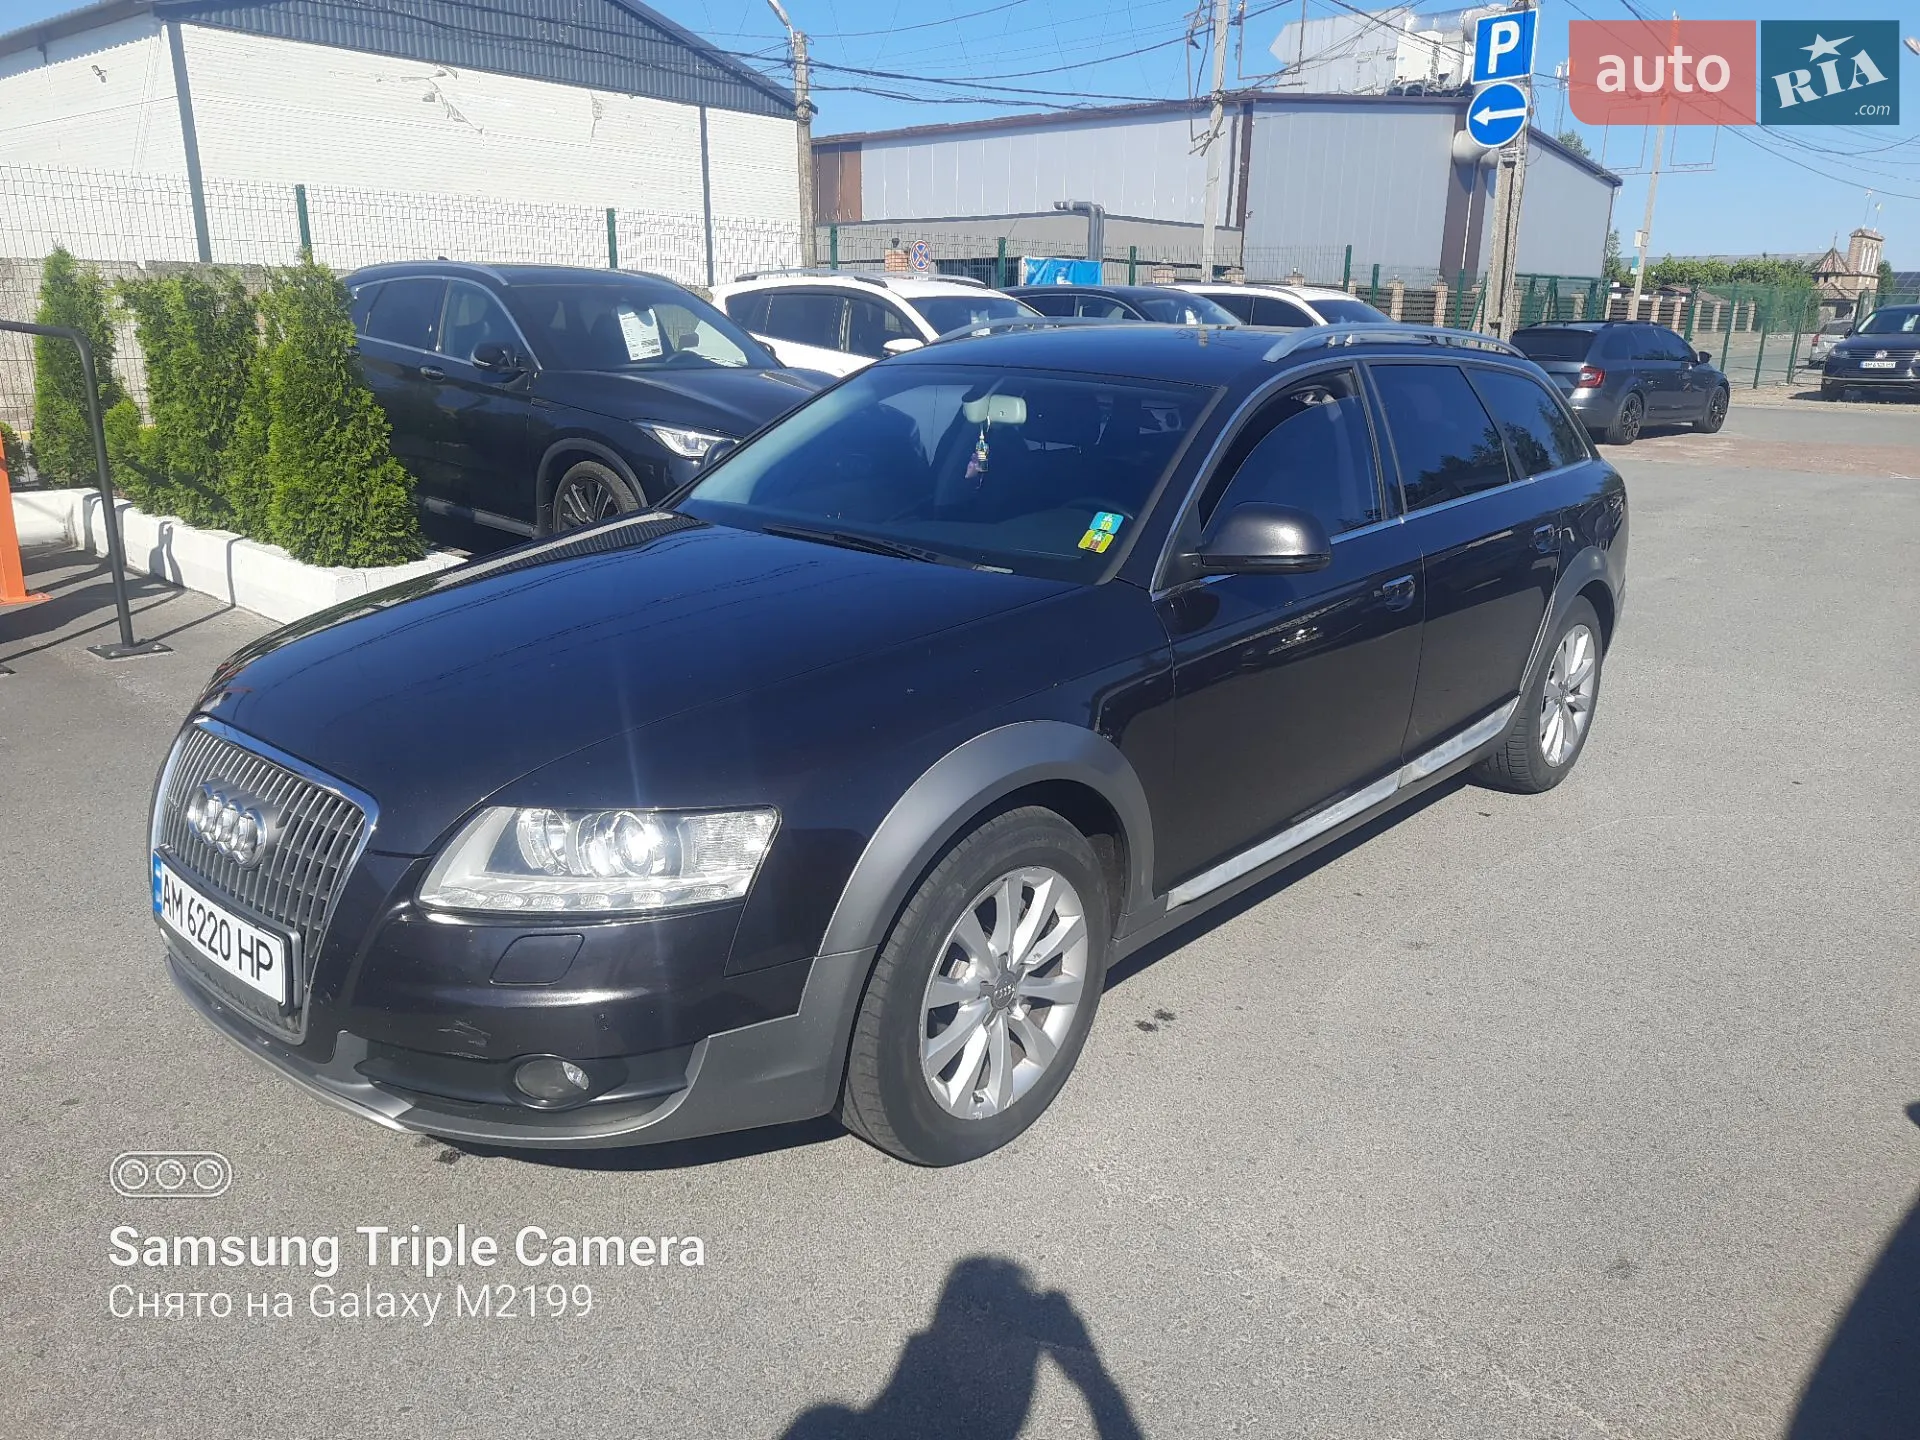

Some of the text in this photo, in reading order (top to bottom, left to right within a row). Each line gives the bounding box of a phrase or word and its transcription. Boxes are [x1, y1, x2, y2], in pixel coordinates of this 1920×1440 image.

[1488, 21, 1520, 74] P
[162, 874, 274, 981] AM 6220 HP
